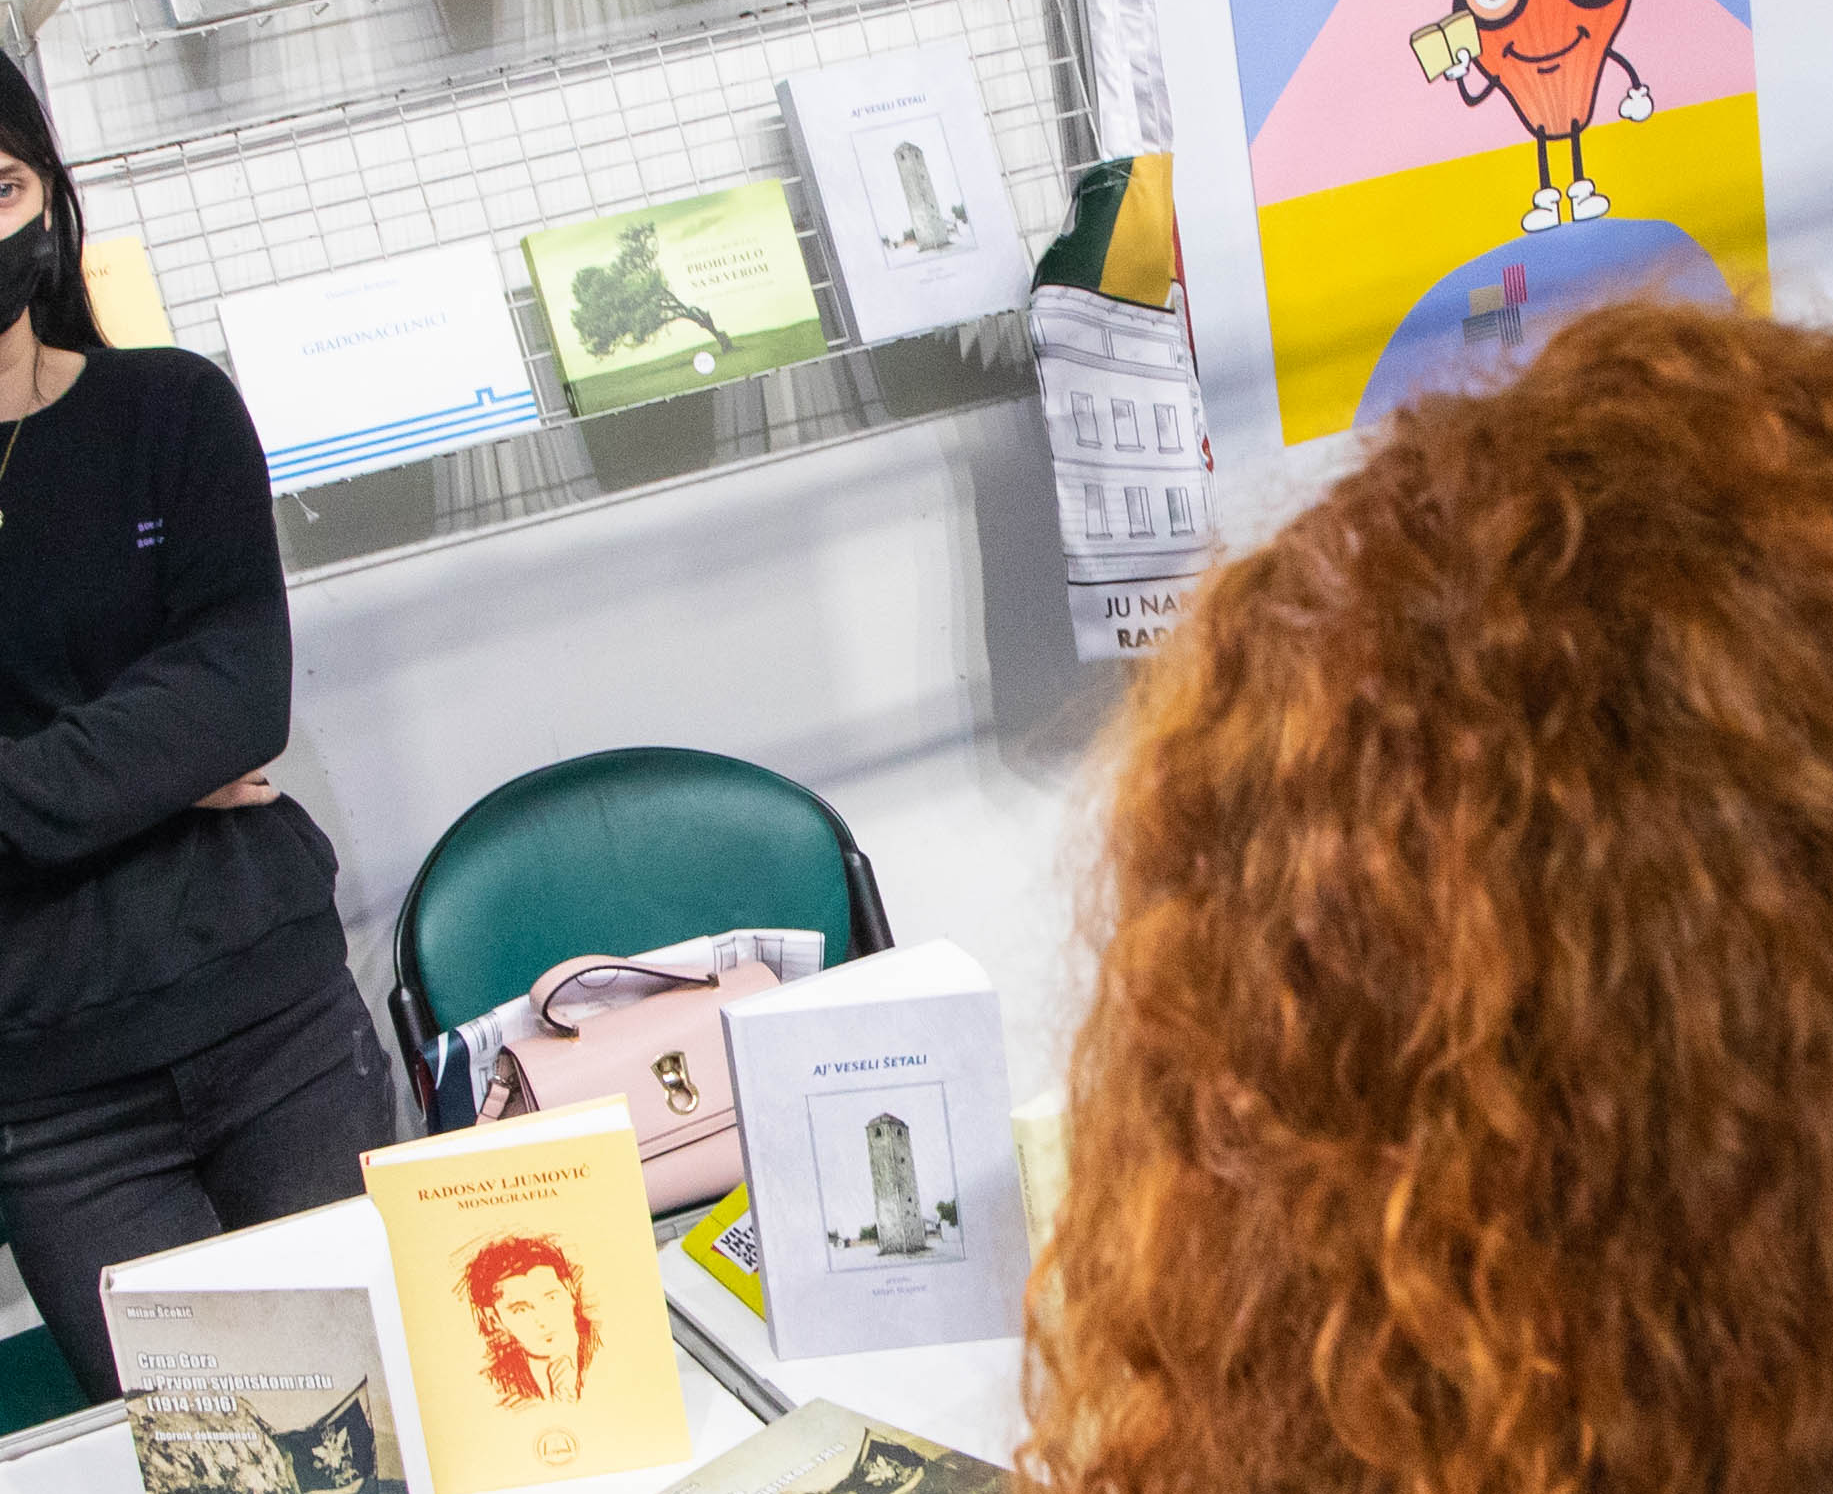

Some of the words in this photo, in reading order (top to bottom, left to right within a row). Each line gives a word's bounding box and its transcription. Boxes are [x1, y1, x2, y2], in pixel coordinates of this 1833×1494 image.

[1105, 596, 1131, 619] JU
[834, 1059, 881, 1075] VESELI
[883, 1053, 928, 1070] ŠETALI
[417, 1178, 497, 1203] RADOSAV
[502, 1163, 592, 1191] LJUMOVIĆ
[457, 1188, 559, 1211] MONOGRAFIJA
[137, 1352, 177, 1370] Crna
[178, 1352, 218, 1370] Gora
[142, 1376, 155, 1391] u
[156, 1374, 208, 1392] Prvom
[210, 1375, 296, 1393] svjetskom
[298, 1372, 334, 1390] ratu
